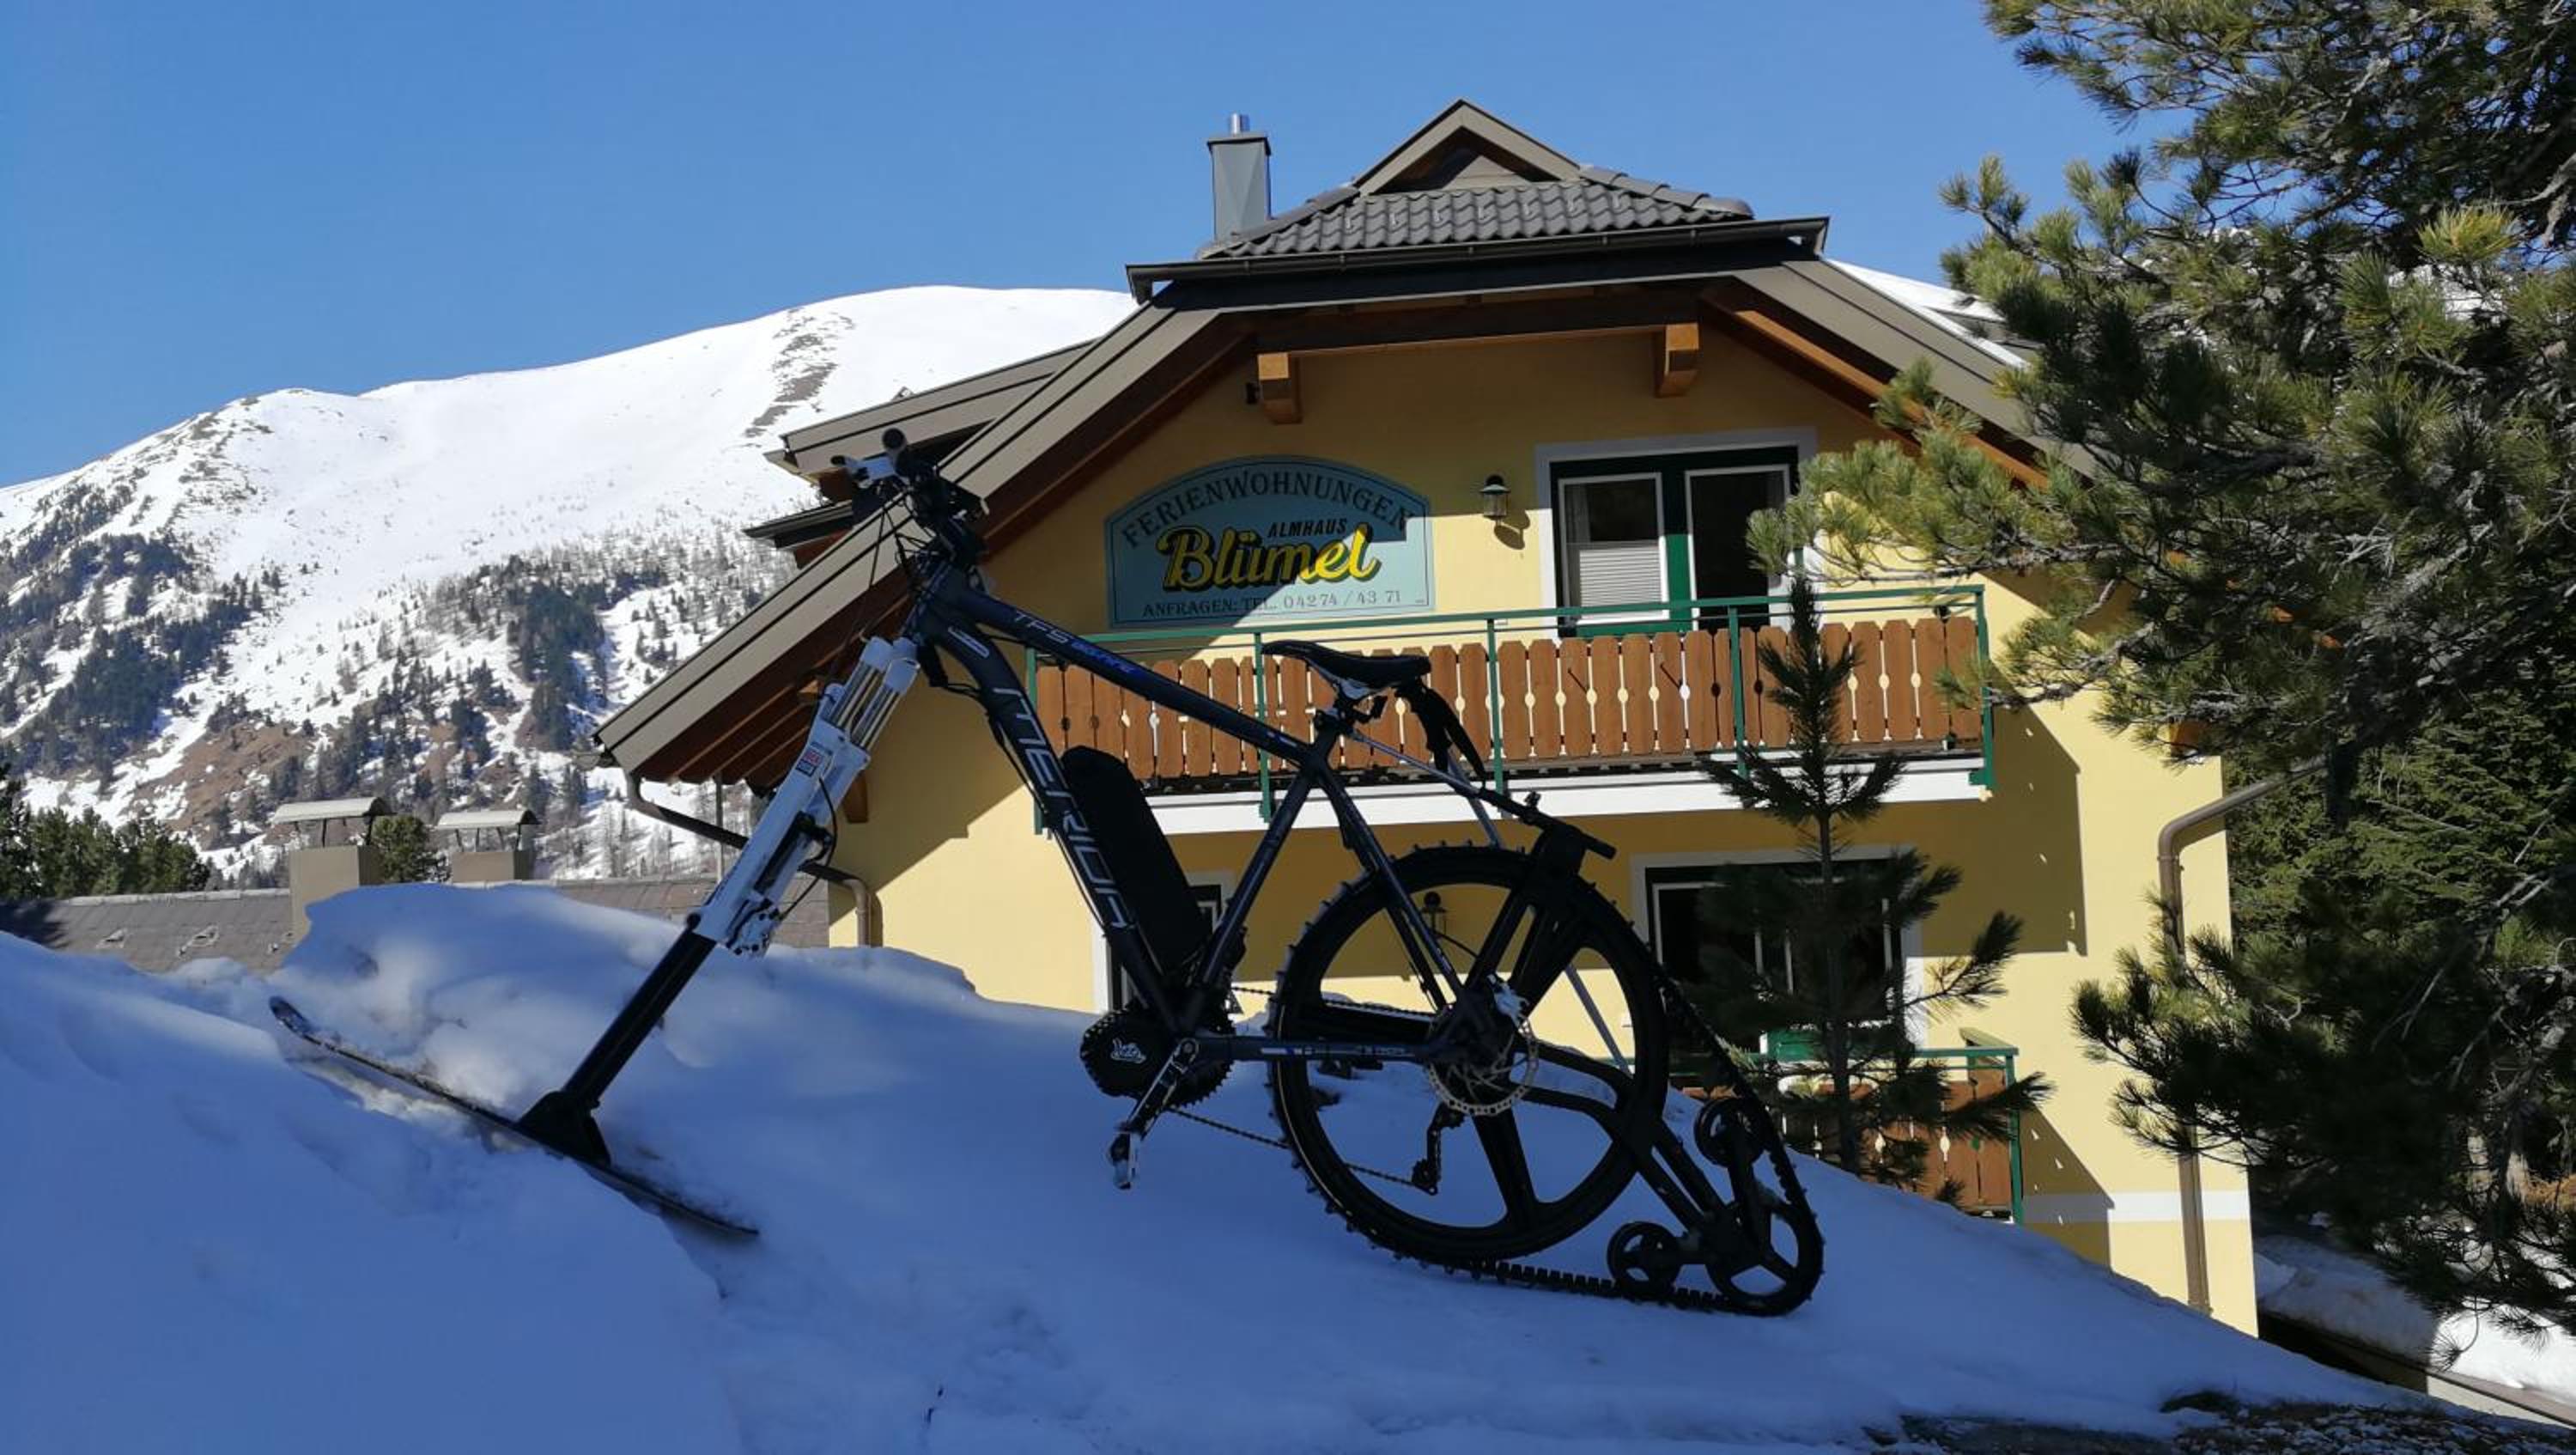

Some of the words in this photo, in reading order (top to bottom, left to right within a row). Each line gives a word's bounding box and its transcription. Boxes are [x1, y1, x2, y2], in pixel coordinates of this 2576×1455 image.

[1121, 469, 1414, 548] FERIENWOHNUNGEN
[1267, 517, 1347, 539] ALMHAUS
[1156, 522, 1381, 593] Blümel
[1284, 593, 1337, 609] 04274
[1357, 590, 1376, 606] 43
[1385, 589, 1400, 603] 71
[994, 685, 1137, 930] MERIDA
